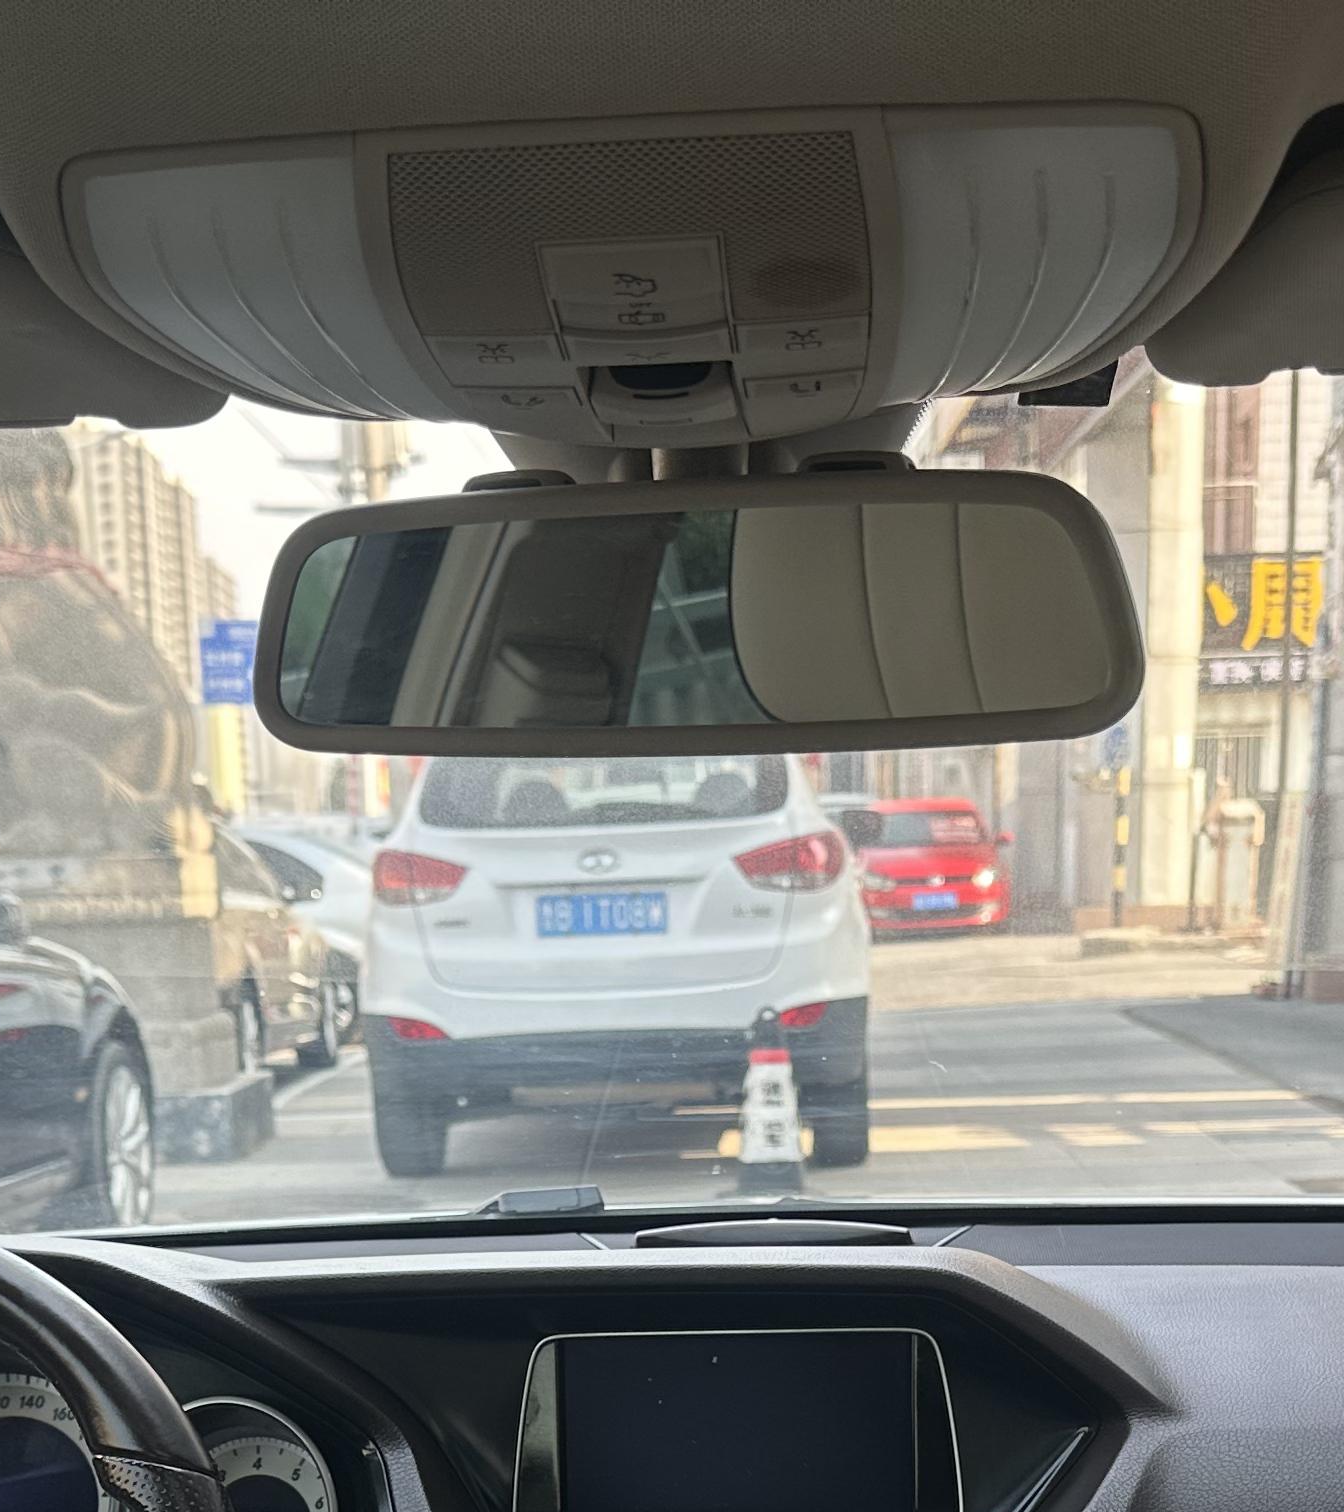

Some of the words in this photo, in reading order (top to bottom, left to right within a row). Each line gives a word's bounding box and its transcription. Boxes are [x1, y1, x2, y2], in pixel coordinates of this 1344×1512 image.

[19, 1396, 45, 1410] 140
[253, 1457, 262, 1470] 4
[291, 1468, 301, 1481] 5
[315, 1497, 324, 1510] 6
